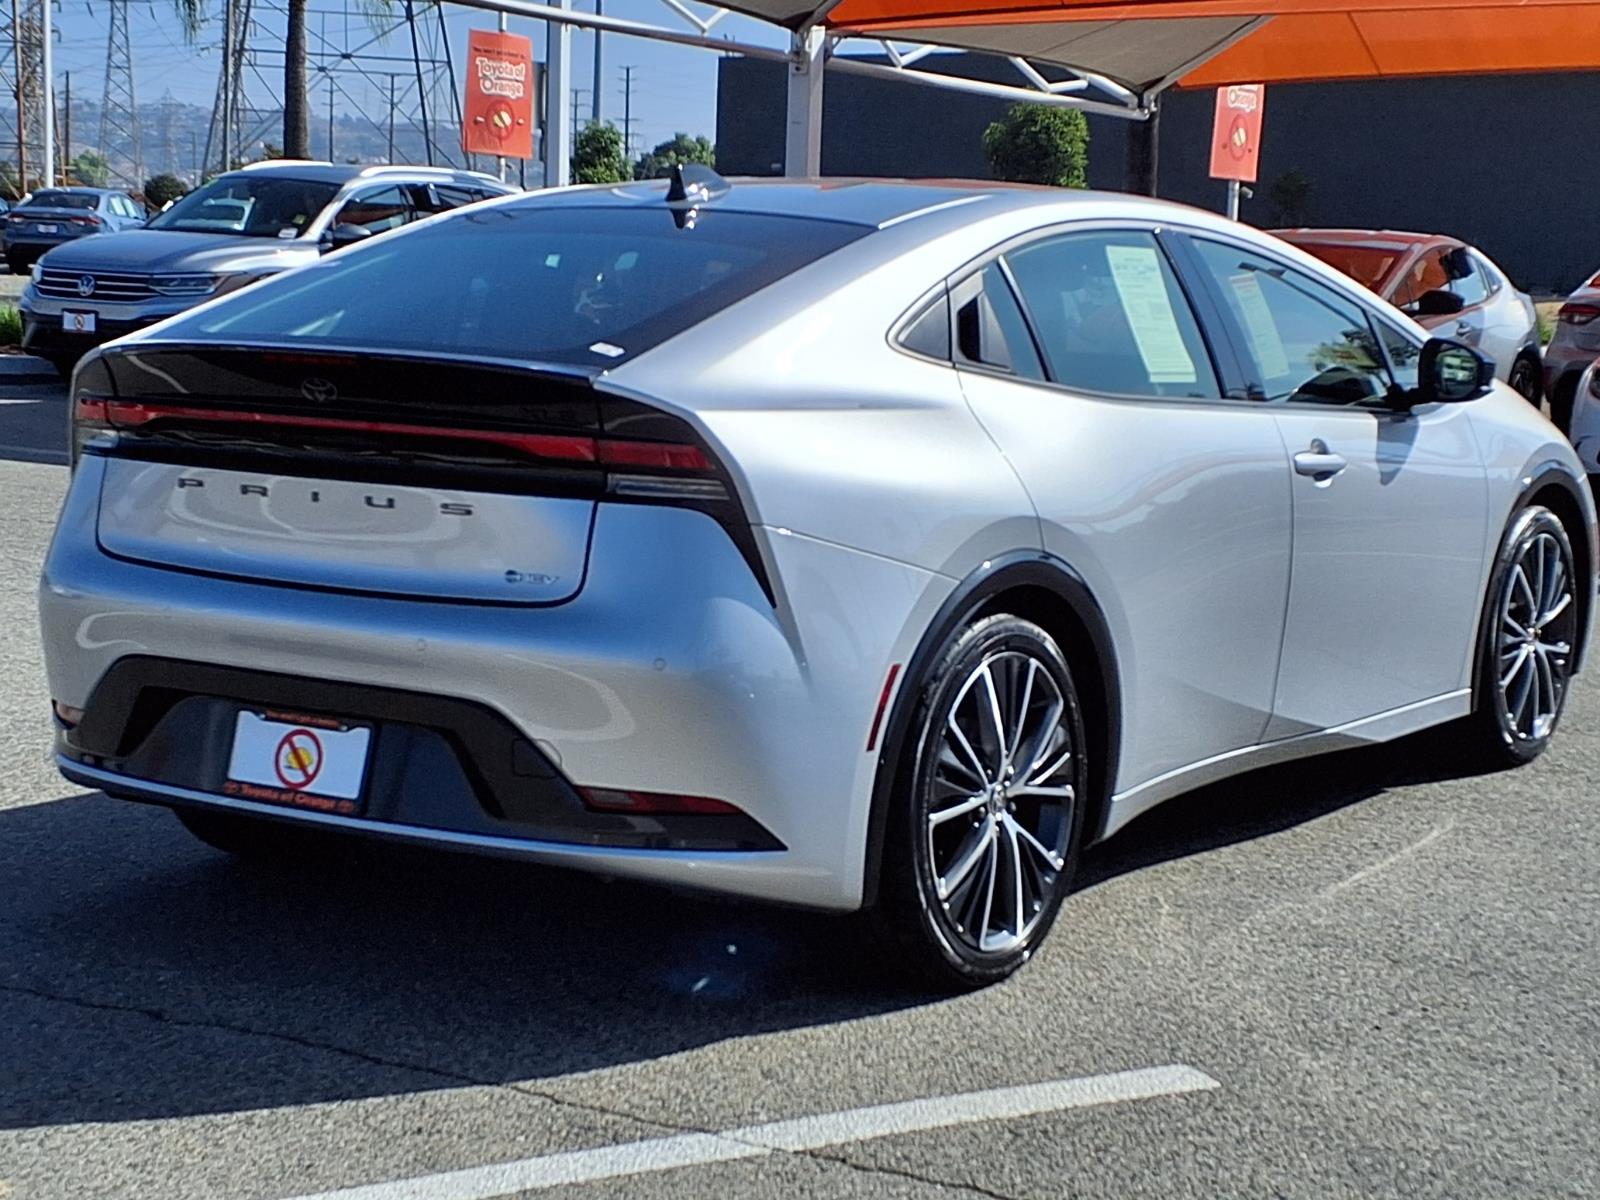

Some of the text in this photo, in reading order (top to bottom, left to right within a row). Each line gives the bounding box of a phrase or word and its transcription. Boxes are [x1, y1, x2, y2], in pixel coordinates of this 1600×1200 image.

[477, 58, 525, 79] Toyota of
[481, 78, 523, 98] Orange
[178, 478, 472, 516] PRIUS
